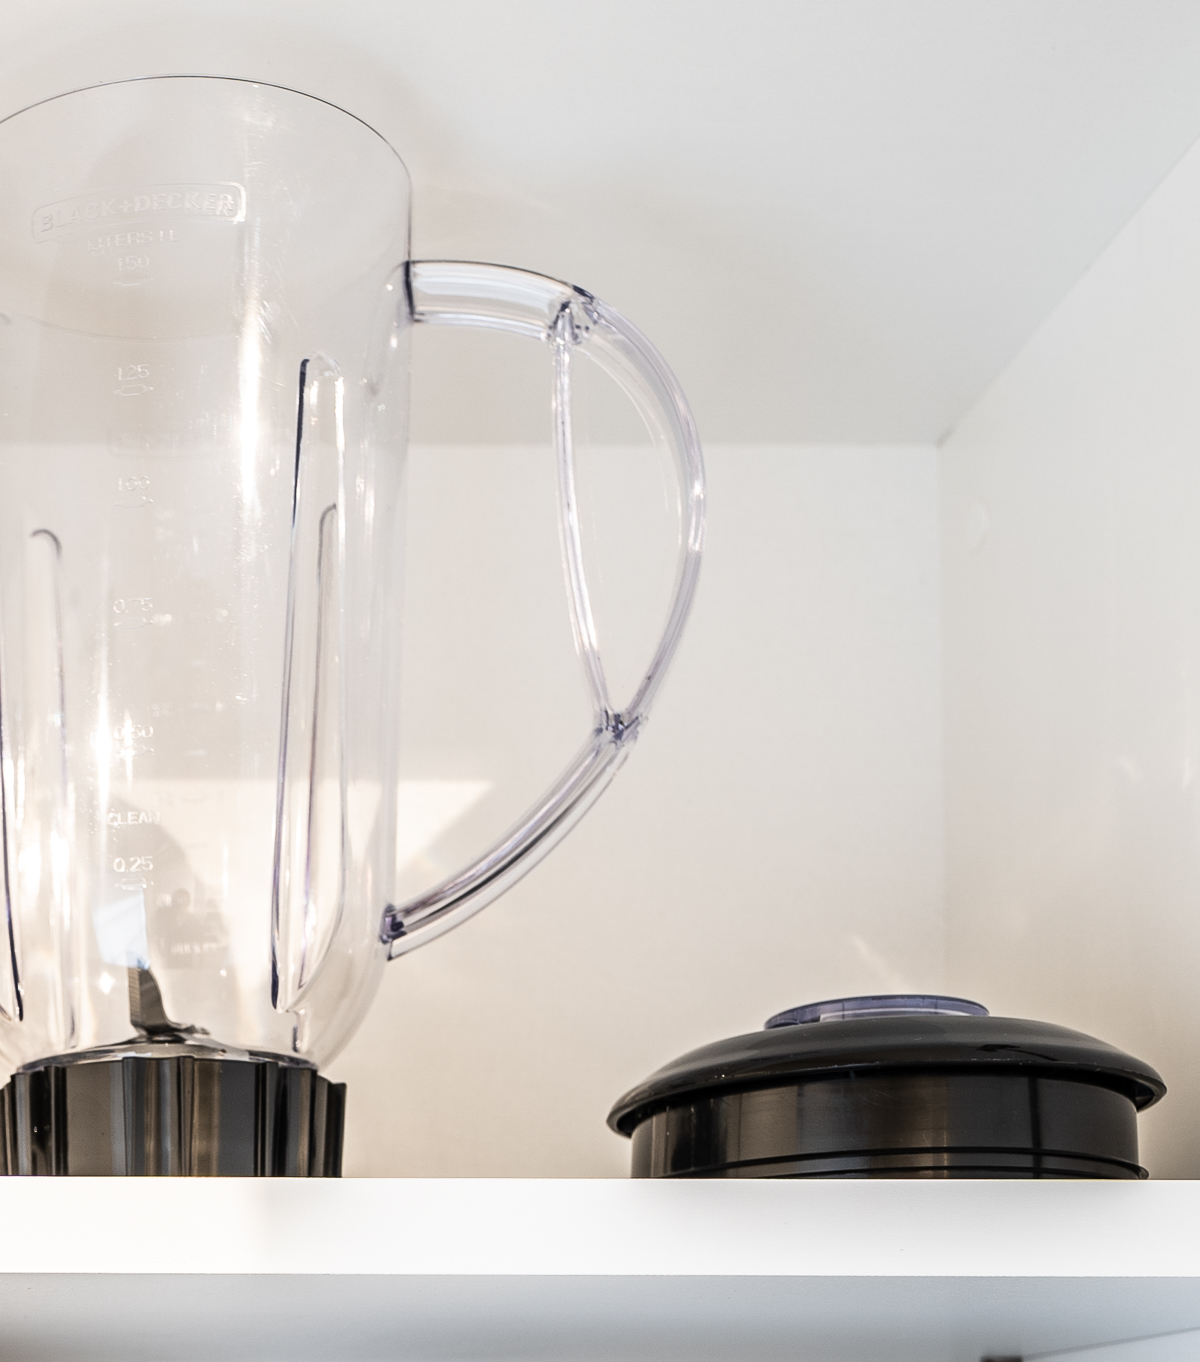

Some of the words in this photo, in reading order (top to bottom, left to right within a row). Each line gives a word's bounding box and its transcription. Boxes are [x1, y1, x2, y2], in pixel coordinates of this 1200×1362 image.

[113, 725, 154, 741] 050
[107, 811, 161, 826] CLEAN
[113, 856, 154, 873] 0.25
